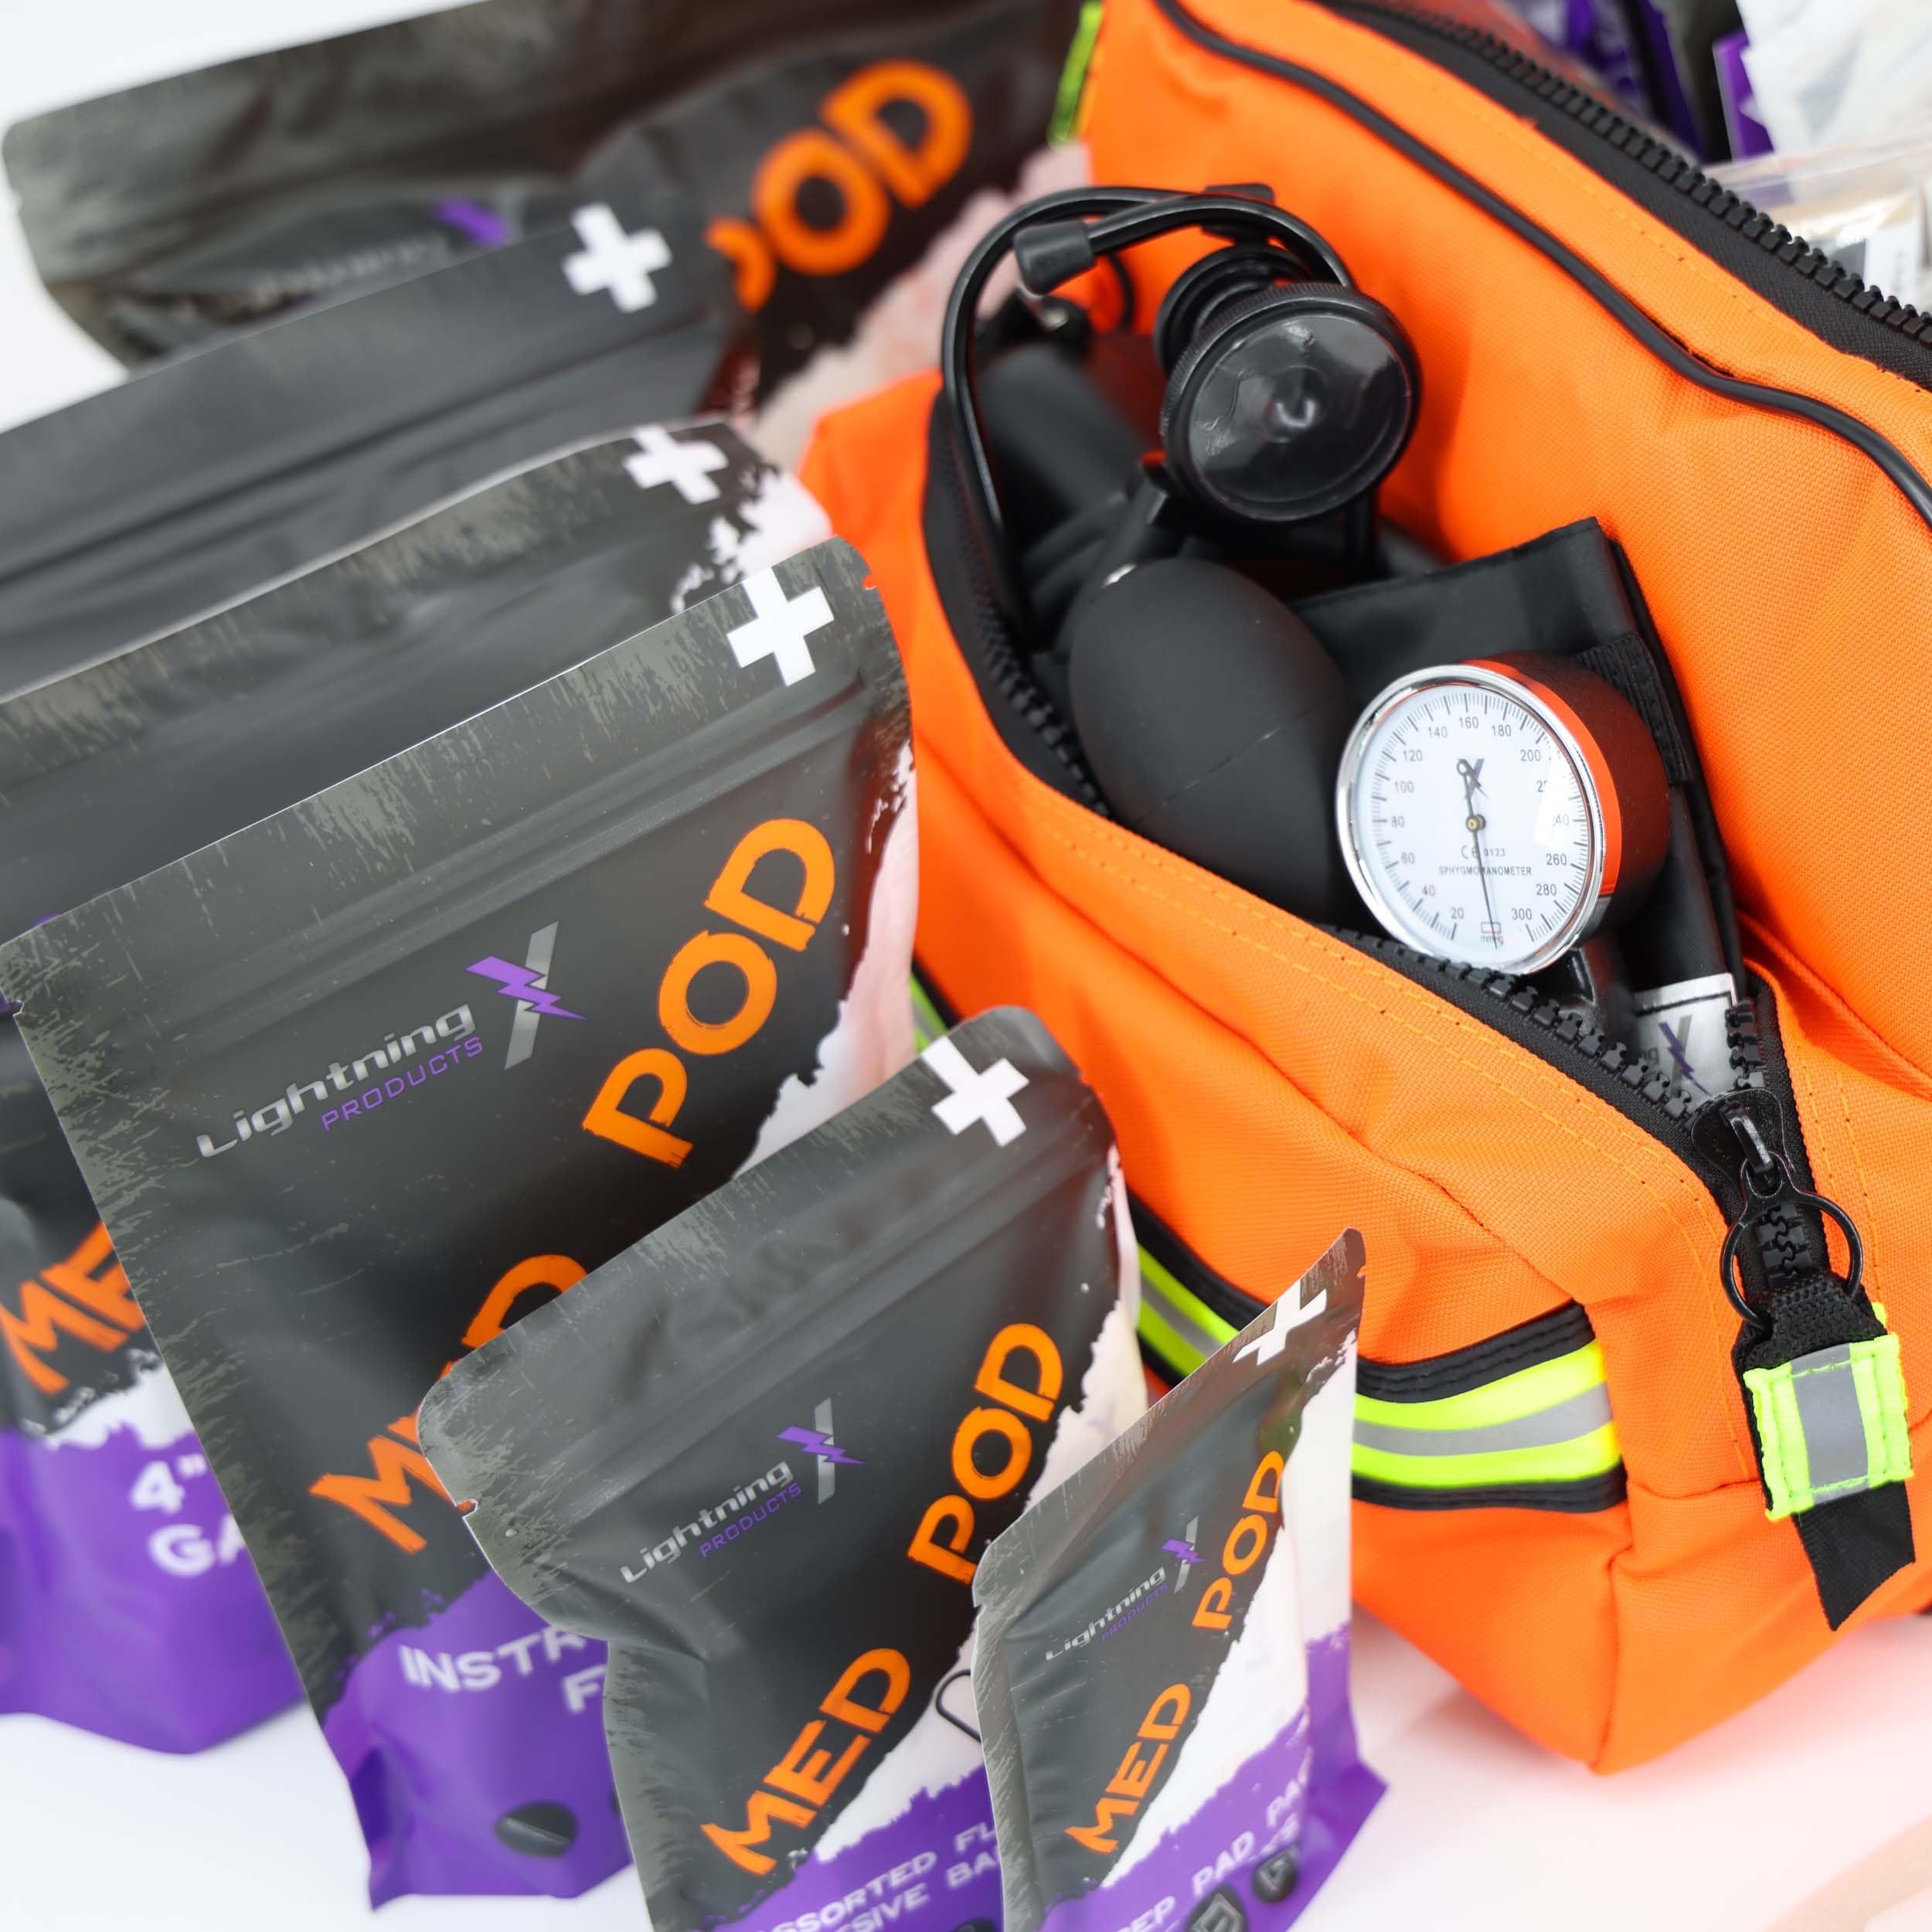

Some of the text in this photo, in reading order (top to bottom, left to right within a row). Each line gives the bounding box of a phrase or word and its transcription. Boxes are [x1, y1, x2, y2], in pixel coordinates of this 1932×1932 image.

[1459, 717, 1478, 729] 160
[1428, 726, 1447, 738] 140
[1492, 725, 1512, 736] 180
[1403, 750, 1423, 761] 120
[1520, 750, 1541, 761] 200
[1394, 781, 1413, 793] 100
[1391, 816, 1405, 828] 80
[1553, 814, 1570, 826] 40
[1401, 852, 1415, 864] 60
[1546, 854, 1567, 866] 260
[1422, 885, 1435, 896] 40
[1536, 883, 1557, 896] 280
[1451, 907, 1464, 919] 20
[1511, 908, 1532, 920] 300
[196, 1004, 477, 1158] Lightning
[321, 1036, 484, 1132] PRODUCTS
[309, 818, 835, 1553] MD POD
[0, 1219, 147, 1394] ME
[620, 1461, 794, 1583] Lightning
[699, 1482, 802, 1558] PRODUCTS
[699, 1322, 1064, 1877] MED POD
[1046, 1566, 1167, 1661] Lightning
[1100, 1582, 1168, 1644] PRODUCTS
[1063, 1450, 1286, 1853] MED POD
[946, 1851, 1000, 1889] BA
[1192, 1830, 1255, 1897] PAD
[755, 1851, 937, 1932] SSORTED
